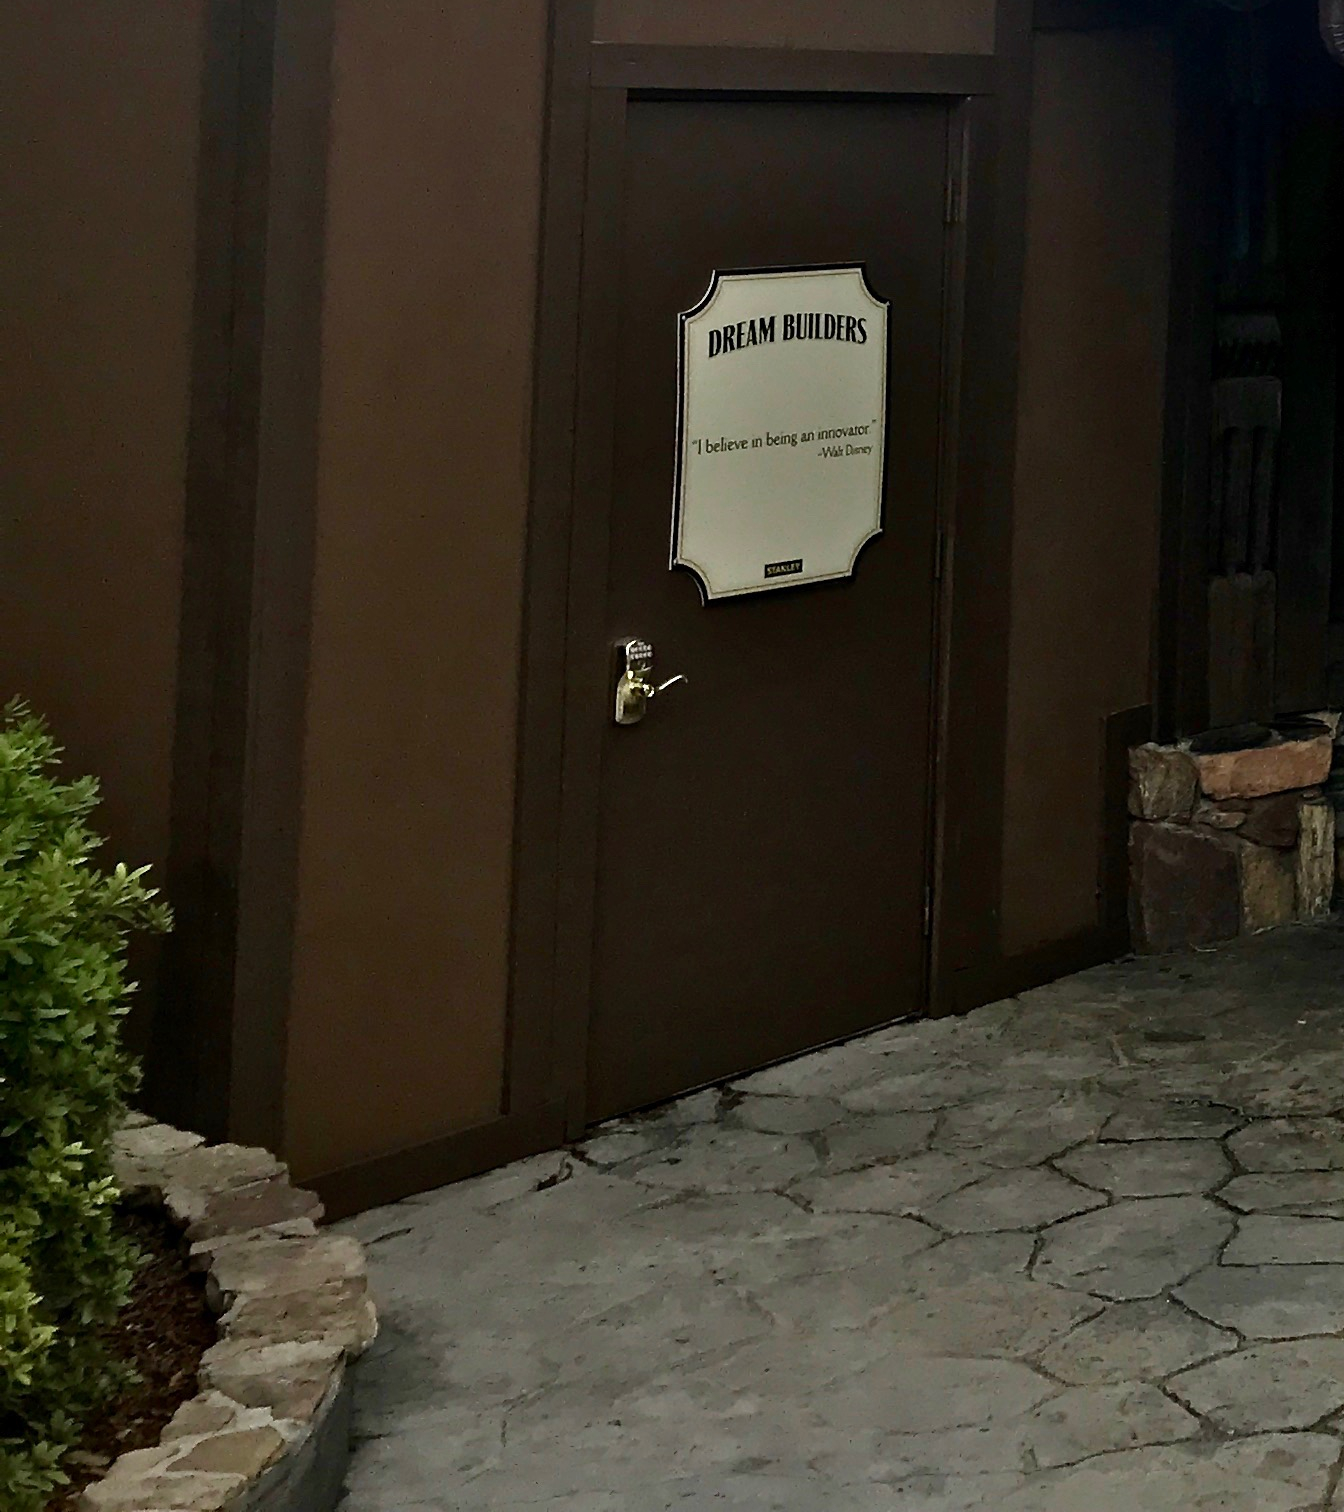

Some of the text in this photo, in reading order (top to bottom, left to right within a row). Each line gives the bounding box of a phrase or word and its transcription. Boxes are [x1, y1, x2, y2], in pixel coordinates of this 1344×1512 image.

[708, 312, 868, 358] DREAM BUILDERS
[705, 437, 748, 454] believe
[751, 437, 763, 448] in
[766, 431, 798, 447] being
[800, 431, 815, 443] an
